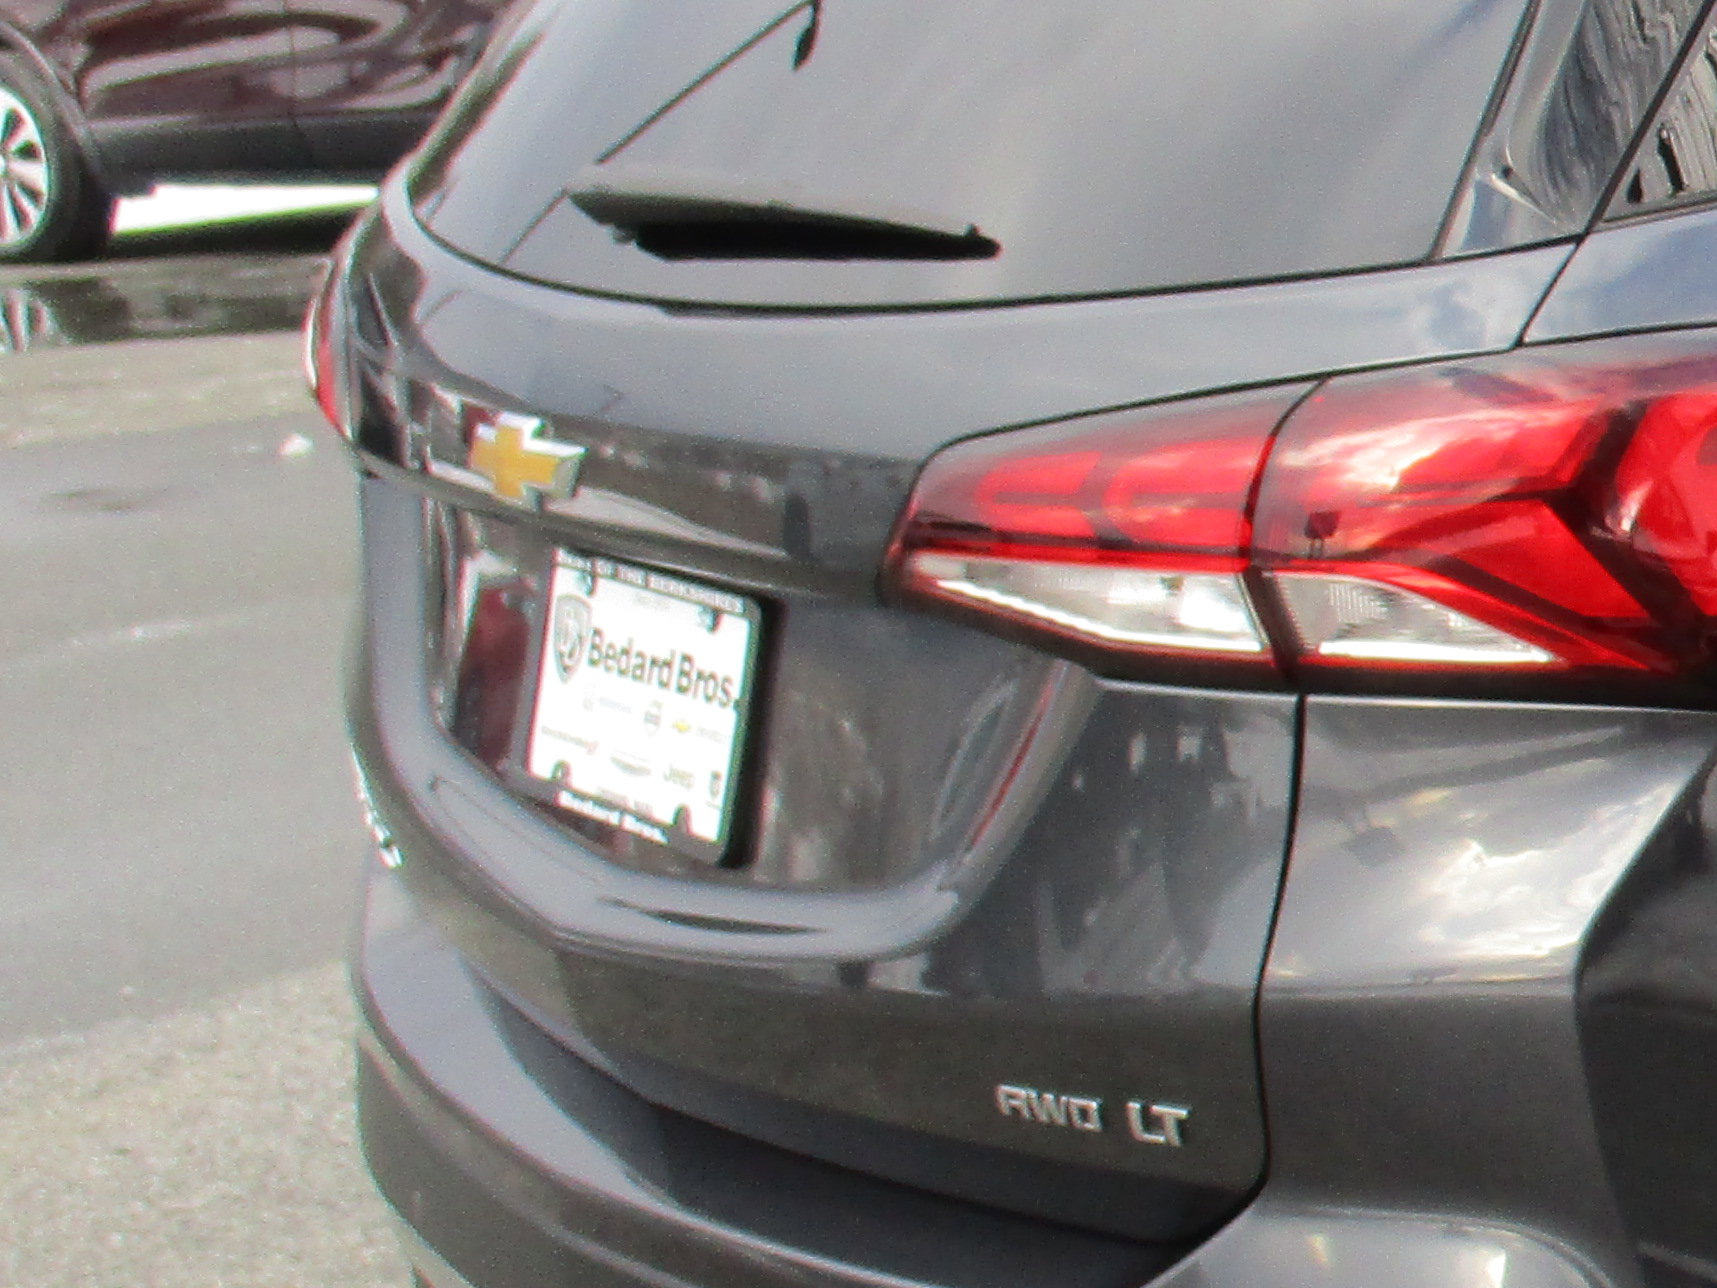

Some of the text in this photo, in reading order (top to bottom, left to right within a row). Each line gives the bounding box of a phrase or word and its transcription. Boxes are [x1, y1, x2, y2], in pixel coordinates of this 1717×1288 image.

[587, 626, 677, 693] Bedard
[994, 1083, 1193, 1147] AWD LT
